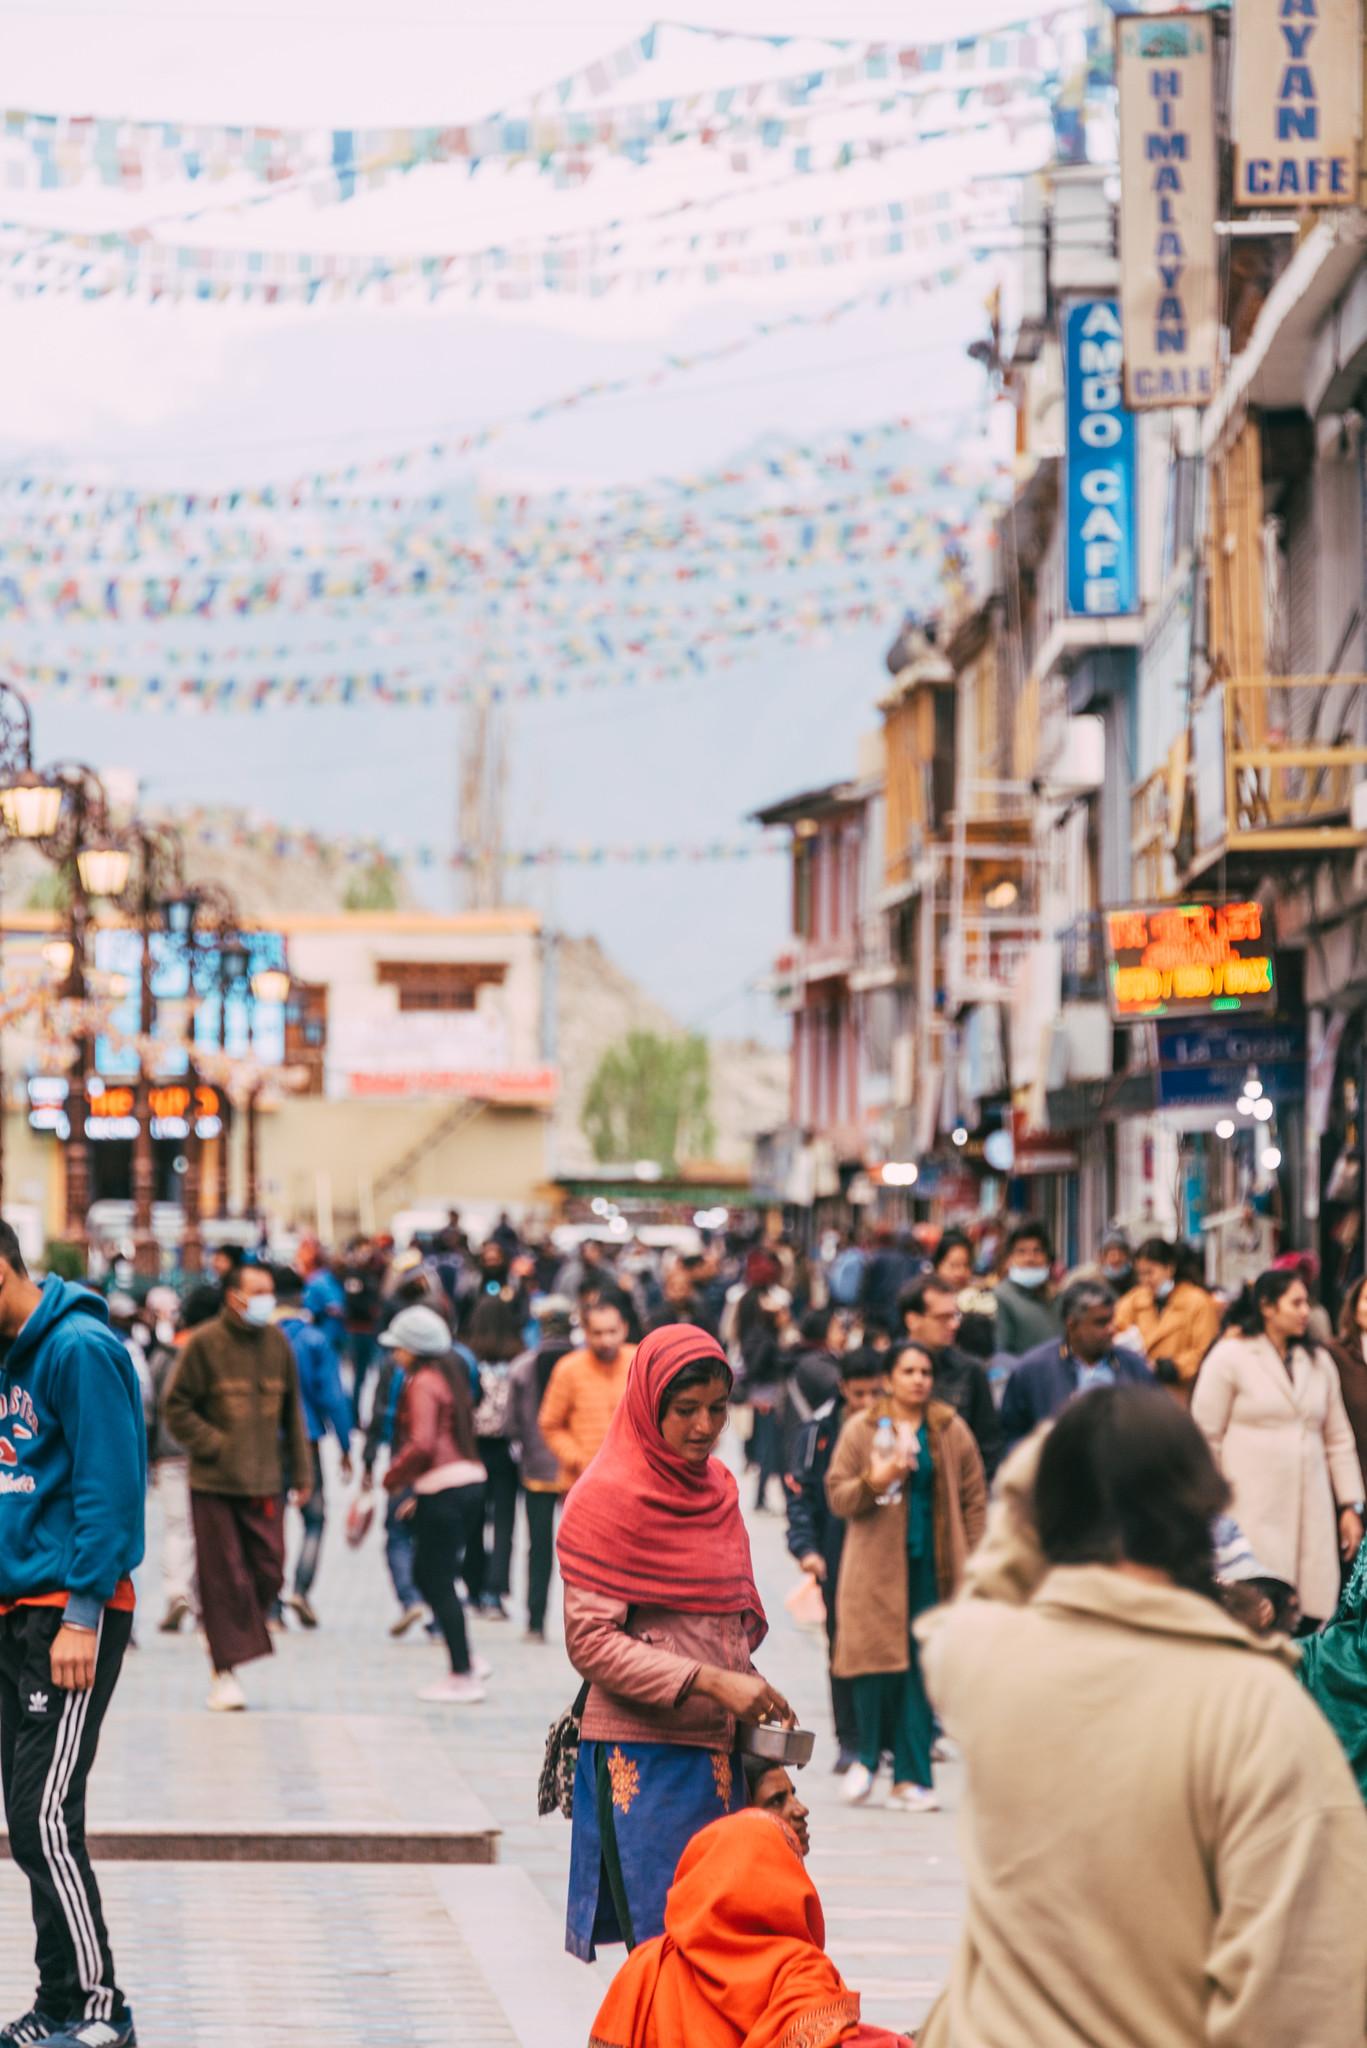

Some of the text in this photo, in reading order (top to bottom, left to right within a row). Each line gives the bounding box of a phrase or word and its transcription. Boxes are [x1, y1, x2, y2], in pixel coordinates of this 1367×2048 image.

[1143, 68, 1190, 354] HIMALAYAN
[1247, 157, 1350, 194] CAFE
[1079, 468, 1123, 613] CAFE
